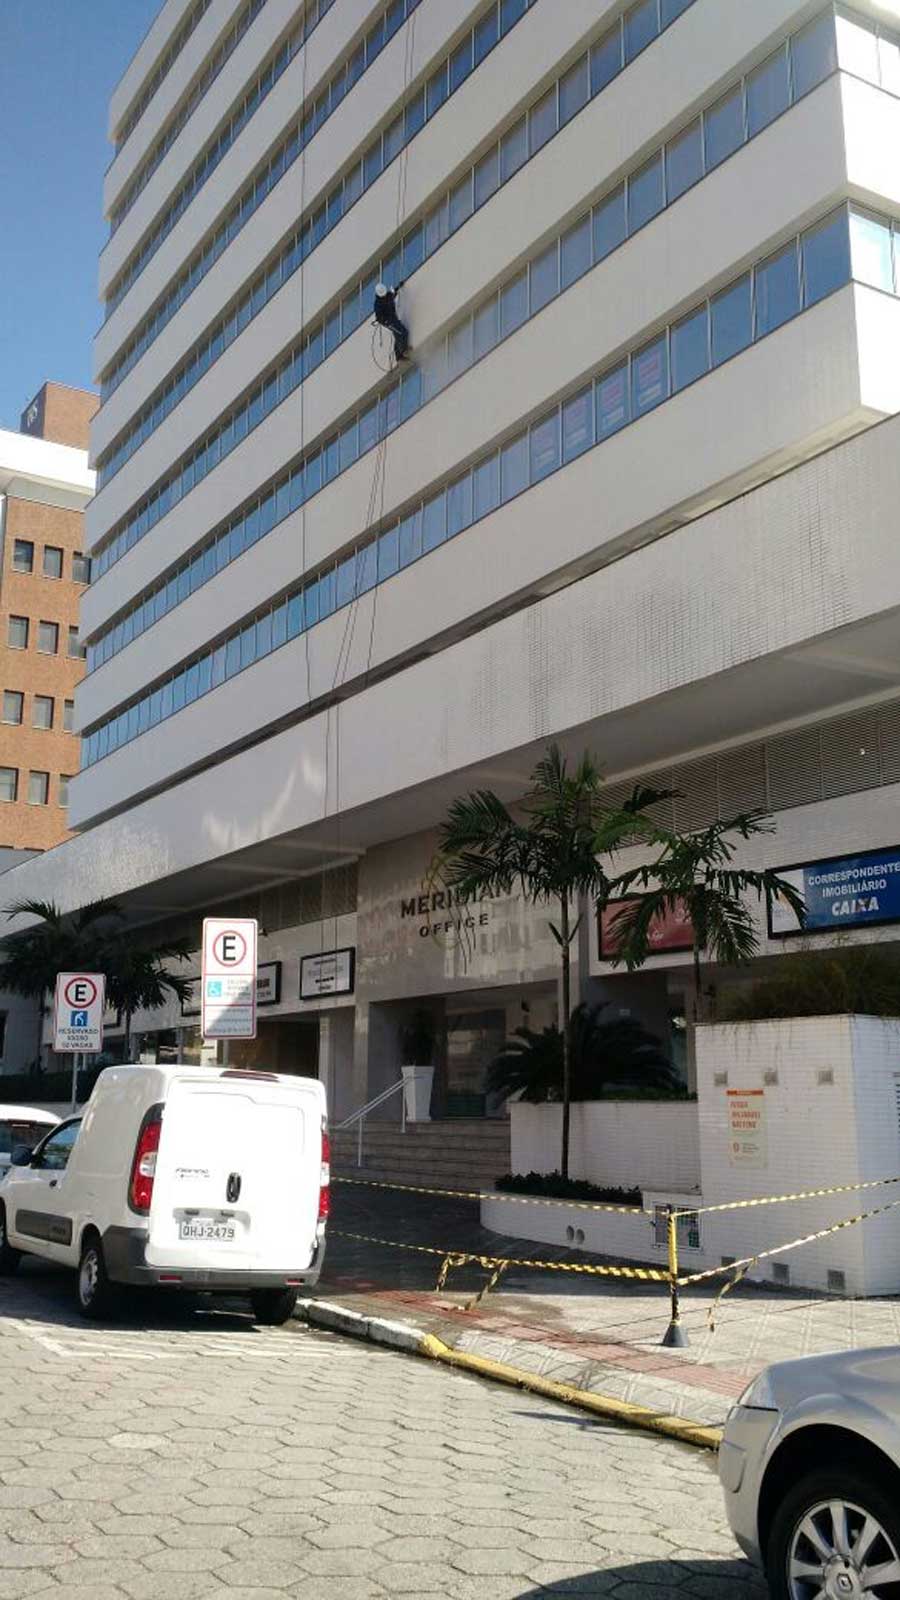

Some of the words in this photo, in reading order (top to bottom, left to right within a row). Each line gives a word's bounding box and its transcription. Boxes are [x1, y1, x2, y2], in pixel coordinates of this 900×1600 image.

[808, 861, 900, 886] CORRESPONDENTE
[822, 879, 887, 898] IMOBILIÁRIO
[831, 896, 879, 916] CAIXA
[419, 913, 489, 938] OFFICE
[223, 935, 236, 961] E
[74, 984, 87, 1002] E
